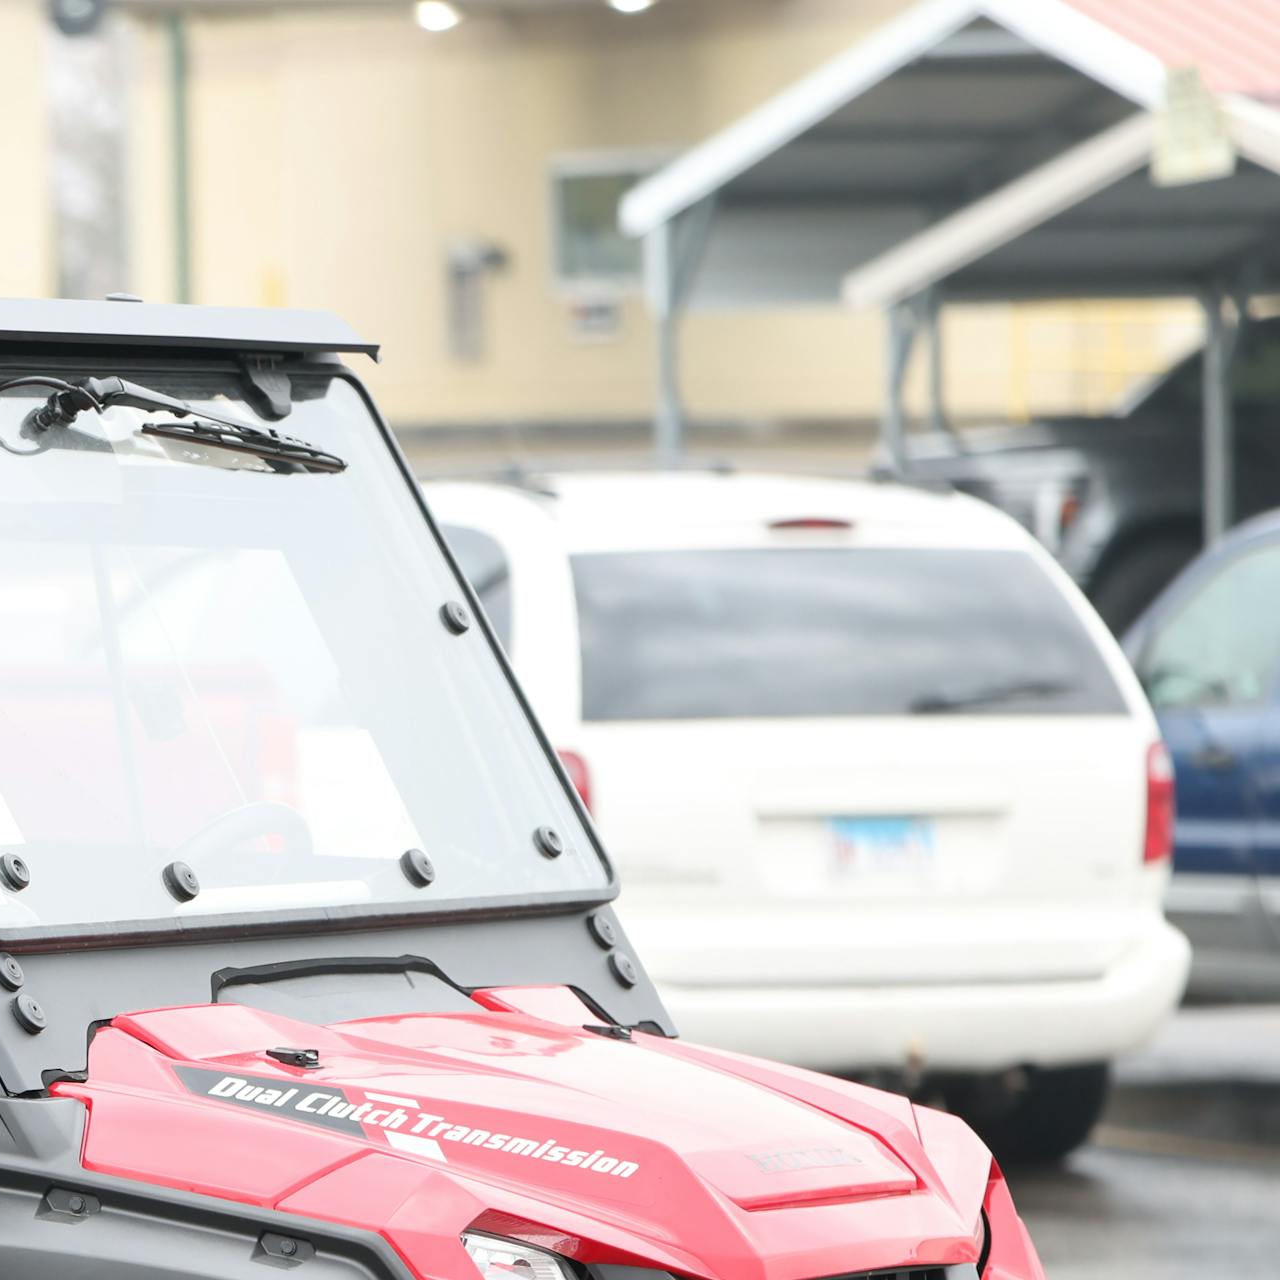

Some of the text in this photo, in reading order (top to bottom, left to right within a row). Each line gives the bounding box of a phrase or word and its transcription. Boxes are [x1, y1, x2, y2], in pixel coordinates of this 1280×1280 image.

[207, 1076, 640, 1179] Dual Clutch Transmission
